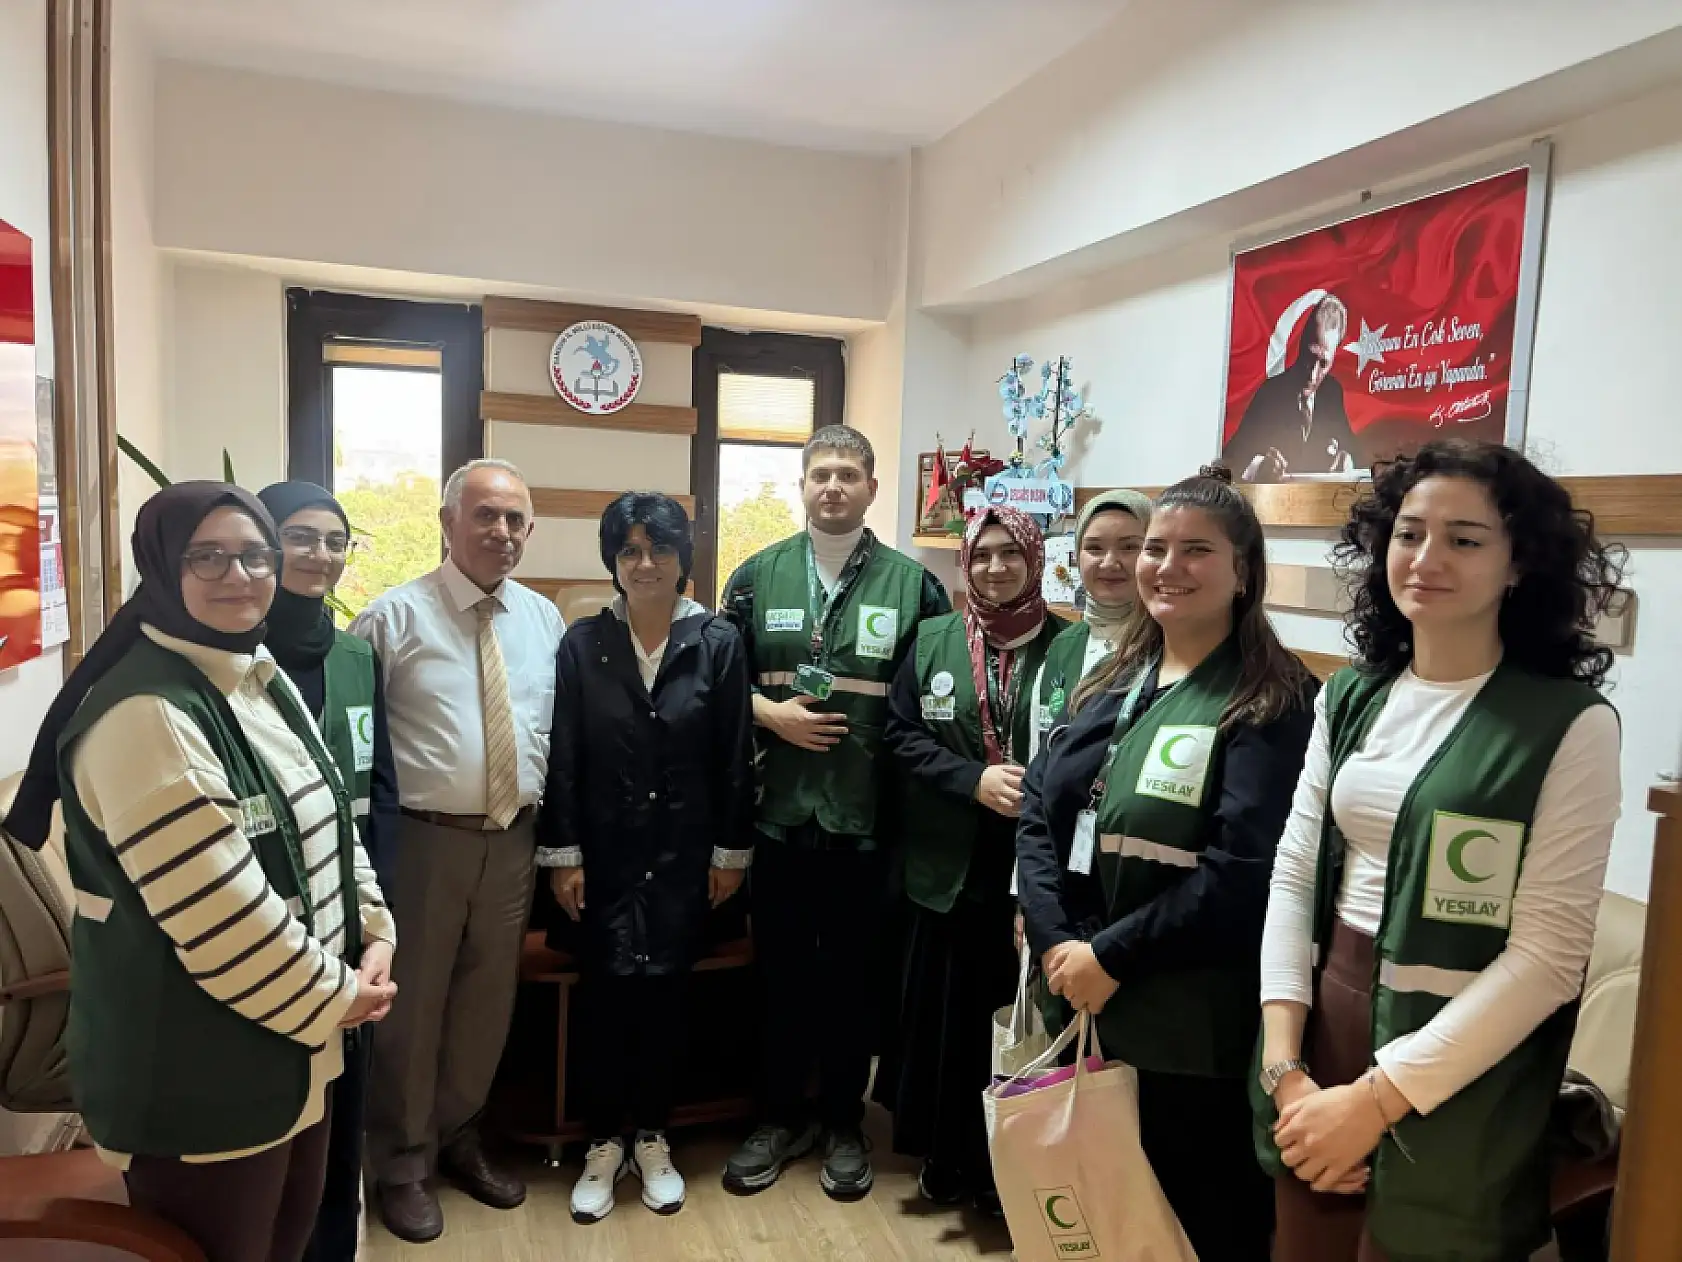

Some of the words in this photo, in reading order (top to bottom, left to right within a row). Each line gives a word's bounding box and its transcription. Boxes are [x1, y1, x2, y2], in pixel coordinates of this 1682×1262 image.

[1403, 323, 1418, 349] En
[1448, 315, 1484, 343] Seven,
[1407, 363, 1422, 389] En
